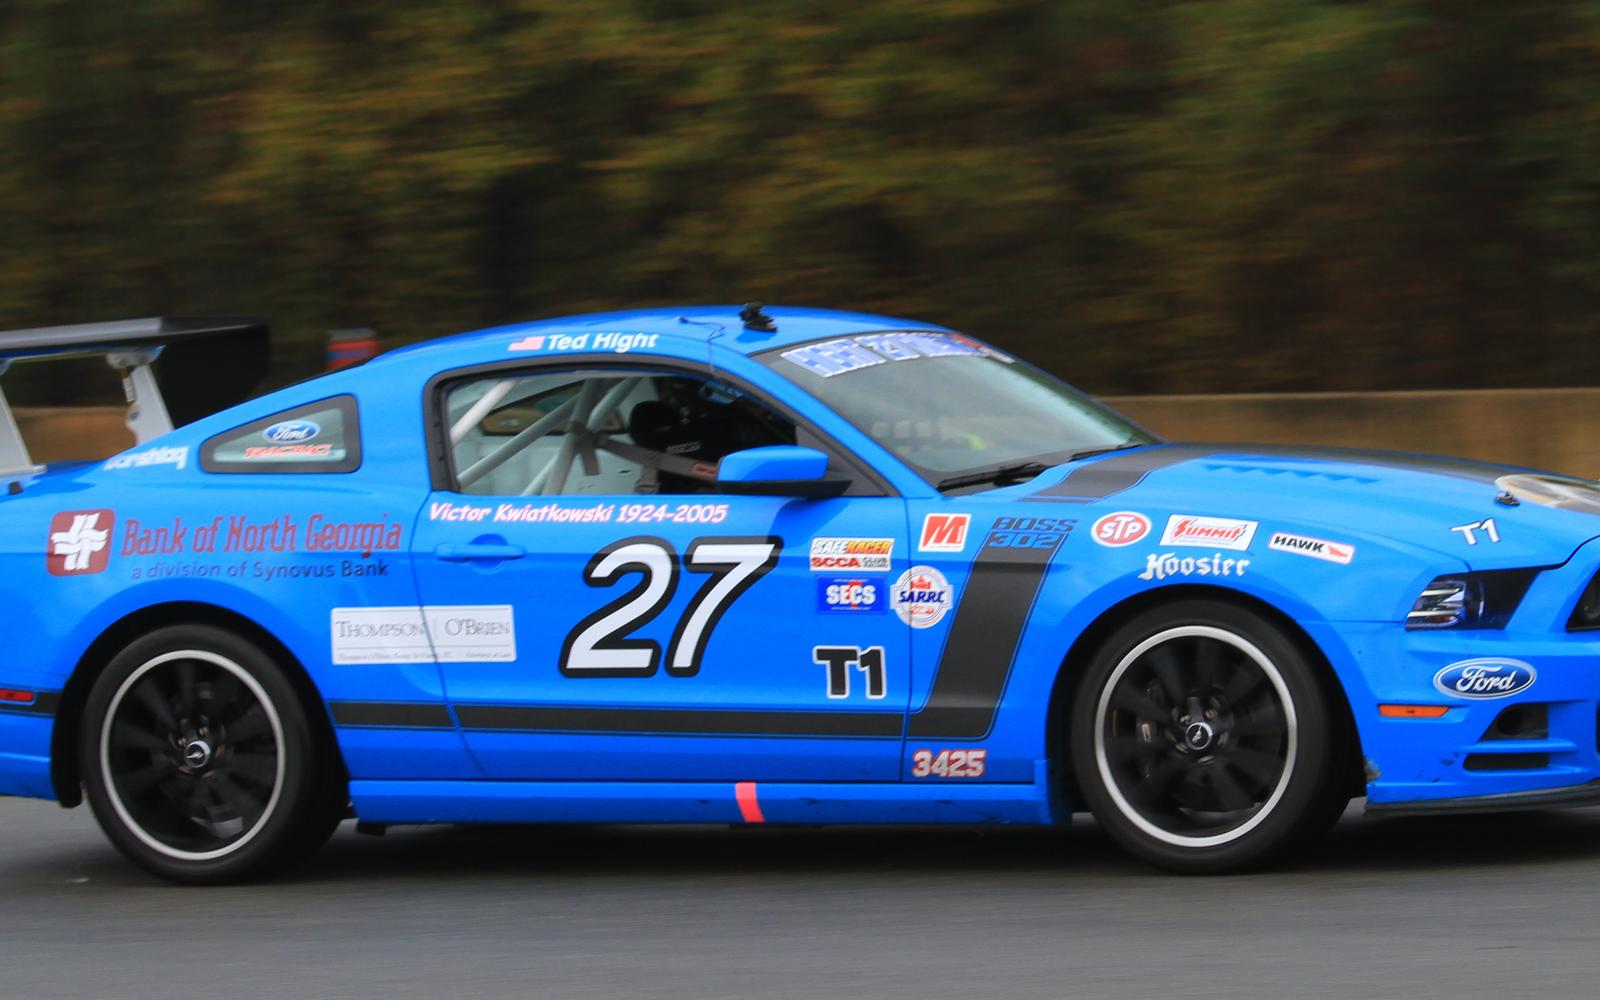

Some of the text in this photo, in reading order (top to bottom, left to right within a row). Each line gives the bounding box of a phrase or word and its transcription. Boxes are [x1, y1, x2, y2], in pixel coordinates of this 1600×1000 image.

[548, 332, 659, 354] Ted Hight
[429, 503, 728, 523] Victor Kwiatkowski 1924-2005
[992, 517, 1078, 531] BOSS
[121, 513, 402, 558] Bank of North Georgia
[1099, 515, 1139, 540] STP
[1450, 518, 1500, 545] T1
[990, 532, 1060, 548] 302
[1273, 535, 1325, 553] HAWK
[132, 559, 389, 581] a division of Synovus Bank
[1138, 553, 1251, 581] Hoosier
[825, 584, 877, 605] SECS
[558, 535, 784, 678] 27
[335, 617, 510, 639] THOMPSON O'BRIEN
[813, 646, 887, 699] T1
[1455, 664, 1517, 693] Ford
[912, 749, 987, 778] 3425
